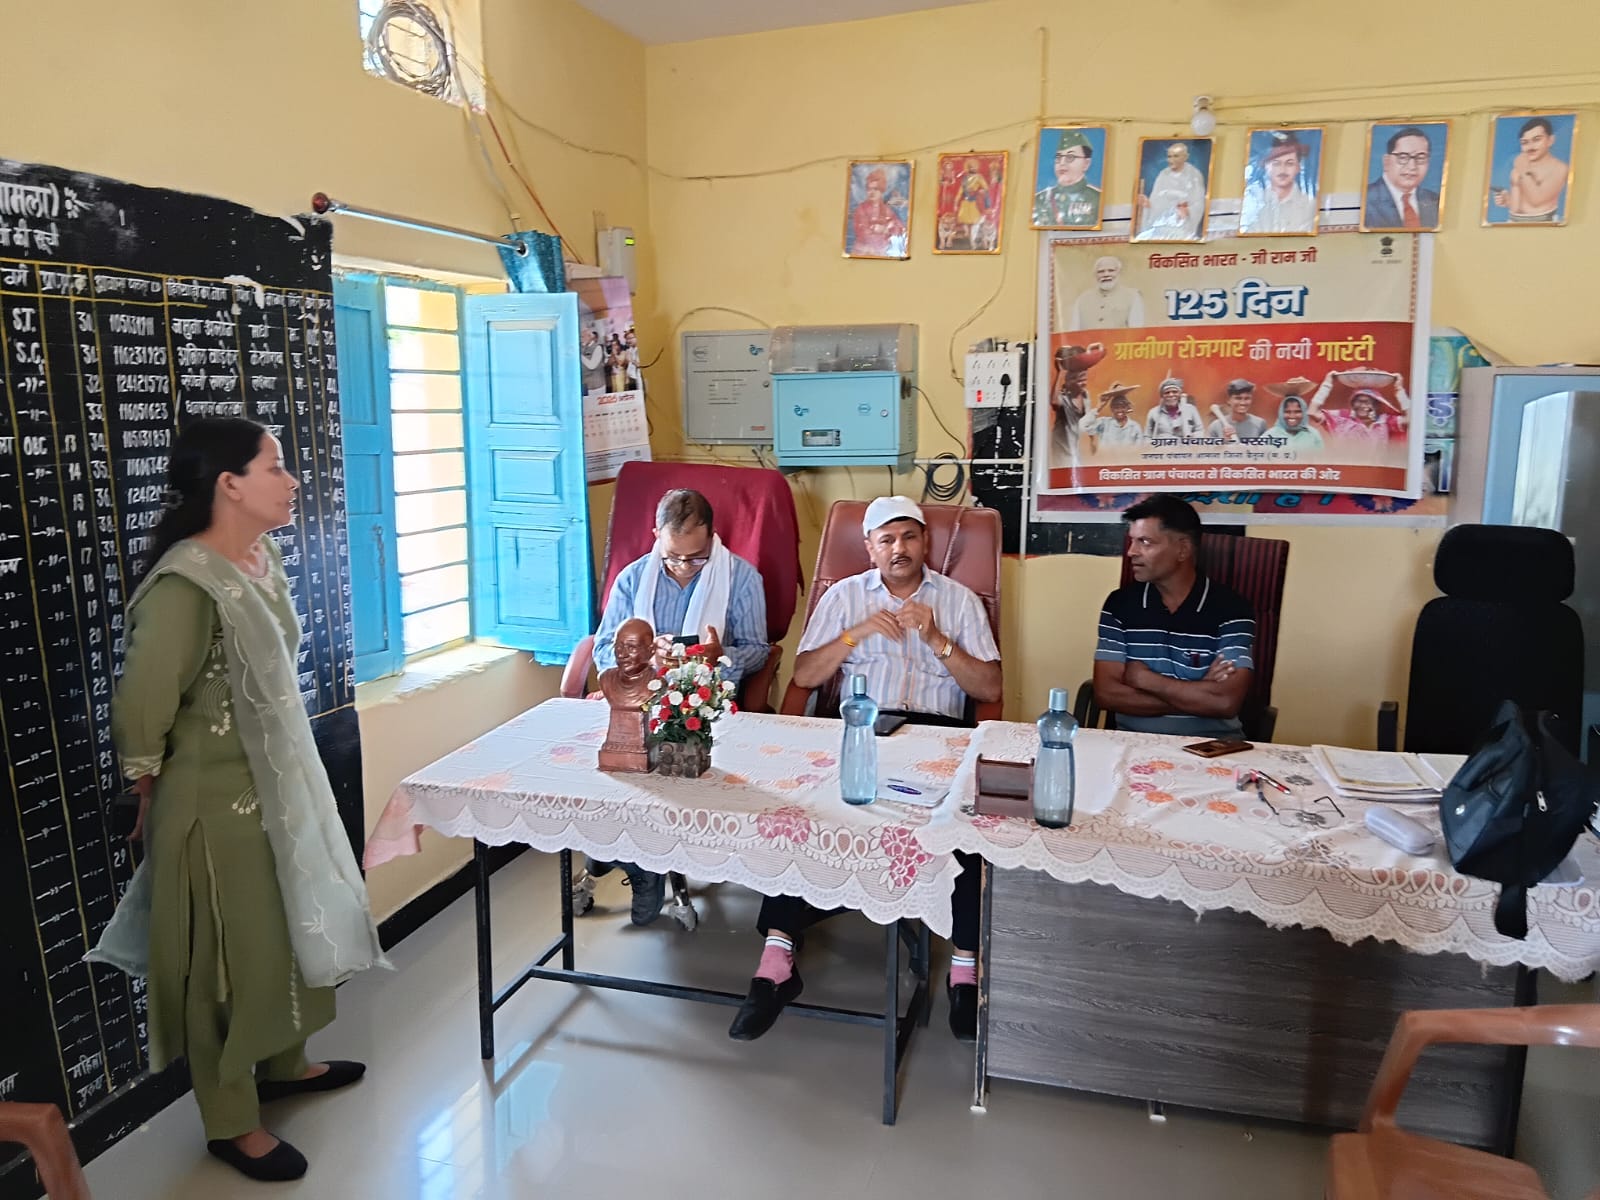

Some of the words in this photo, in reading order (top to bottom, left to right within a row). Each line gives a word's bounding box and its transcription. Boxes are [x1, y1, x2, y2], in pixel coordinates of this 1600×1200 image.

[1149, 253, 1200, 268] विकसित
[1203, 253, 1238, 267] भारत
[1251, 249, 1267, 265] जी
[1271, 251, 1296, 264] राम
[1300, 247, 1317, 263] जी
[1165, 288, 1228, 320] 125
[1233, 276, 1309, 318] दिन
[1114, 336, 1174, 361] ग्रामीण
[1177, 335, 1246, 360] रोजगार
[1248, 338, 1272, 361] की
[1275, 338, 1312, 360] नयी
[1316, 335, 1376, 362] गारंटी
[23, 436, 48, 456] OBC
[65, 434, 76, 453] 13
[1151, 438, 1178, 448] ग्राम
[1181, 435, 1225, 446] पंचायत
[69, 462, 82, 481] 14
[1099, 468, 1140, 480] विकसित
[1143, 470, 1166, 479] ग्राम
[1168, 467, 1205, 479] पंचायत
[1207, 467, 1218, 479] से
[1220, 466, 1266, 479] विकसित
[1268, 469, 1298, 479] भारत
[1300, 467, 1317, 479] की
[1319, 467, 1341, 480] ओर
[73, 493, 84, 512] 15
[77, 520, 88, 537] 16
[81, 547, 92, 565] 17
[83, 574, 95, 593] 18
[87, 599, 98, 618] 19
[89, 627, 102, 645] 20
[91, 651, 102, 670] 21
[93, 676, 107, 696] 22
[96, 703, 109, 721] 23
[98, 726, 110, 743] 24
[100, 751, 113, 768] 25
[101, 774, 113, 790] 26
[114, 848, 126, 867] 29
